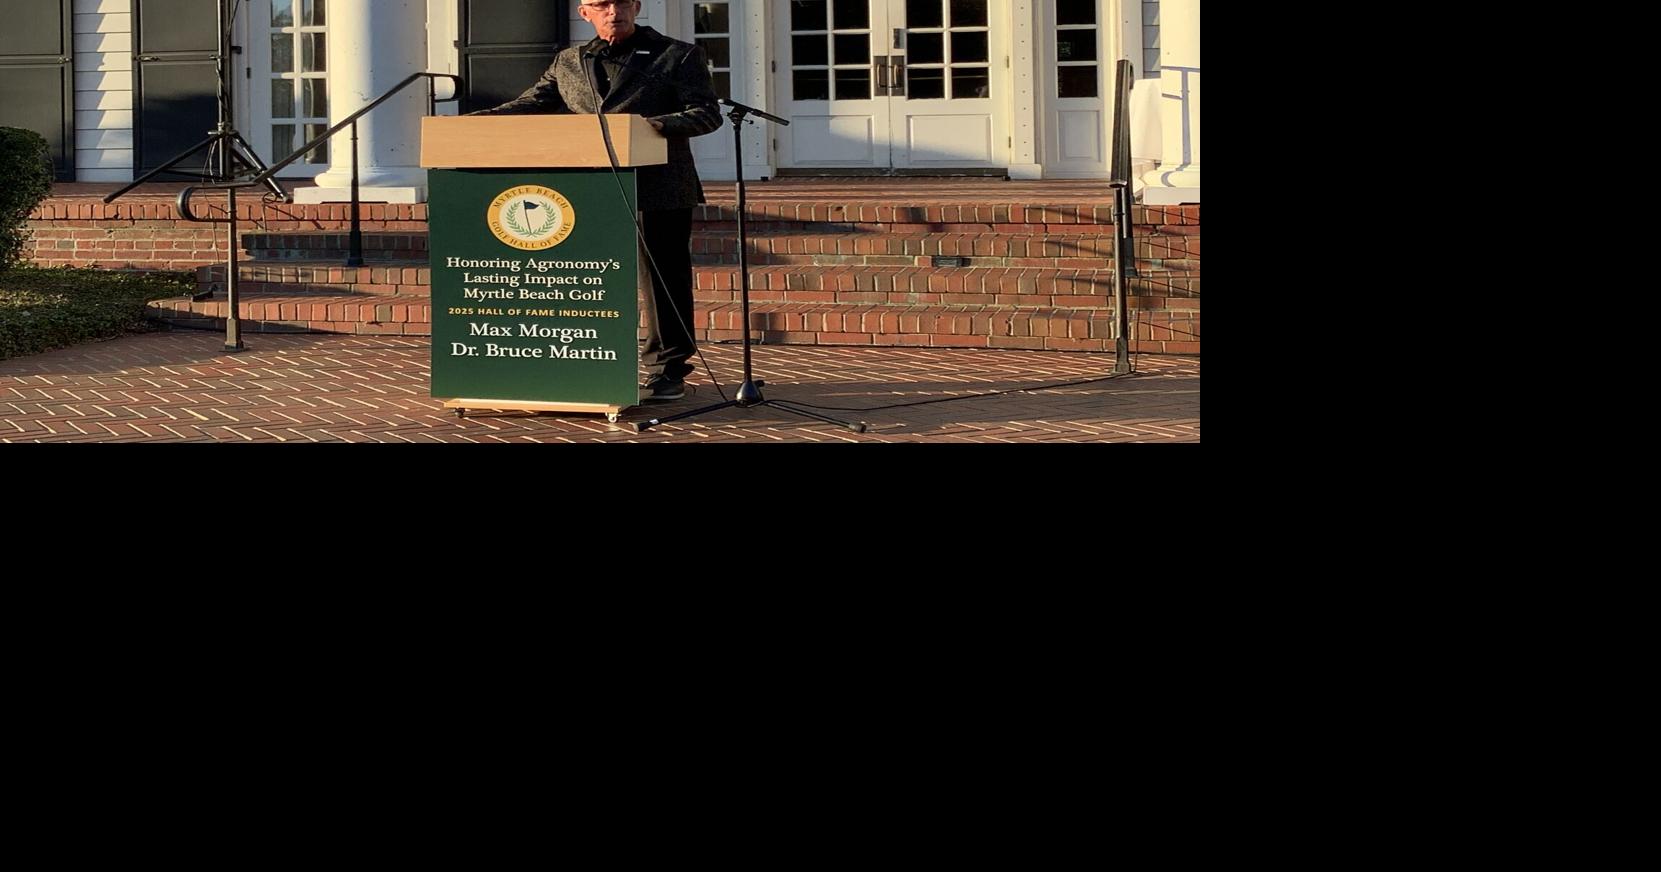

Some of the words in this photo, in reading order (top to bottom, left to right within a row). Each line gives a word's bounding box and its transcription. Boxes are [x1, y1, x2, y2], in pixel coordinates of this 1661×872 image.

[493, 187, 530, 208] MYRTLE
[536, 187, 569, 209] BEACH
[492, 221, 508, 241] GOLF
[510, 238, 537, 249] HALL
[553, 222, 571, 242] FAME
[446, 257, 521, 271] Honoring
[463, 272, 520, 287] Lasting
[524, 273, 579, 287] Impact
[583, 276, 603, 285] on
[464, 288, 514, 302] Myrtle
[519, 288, 564, 300] Beach
[569, 289, 606, 301] Golf
[448, 307, 474, 315] 2025
[478, 308, 504, 316] HALL
[507, 308, 522, 316] OF
[526, 309, 555, 317] FAME
[559, 309, 620, 318] INDUCTEES
[469, 323, 513, 337] Max
[518, 323, 598, 343] Morgan
[451, 343, 480, 357] Dr.
[485, 343, 543, 358] Bruce
[549, 345, 618, 361] Martin
